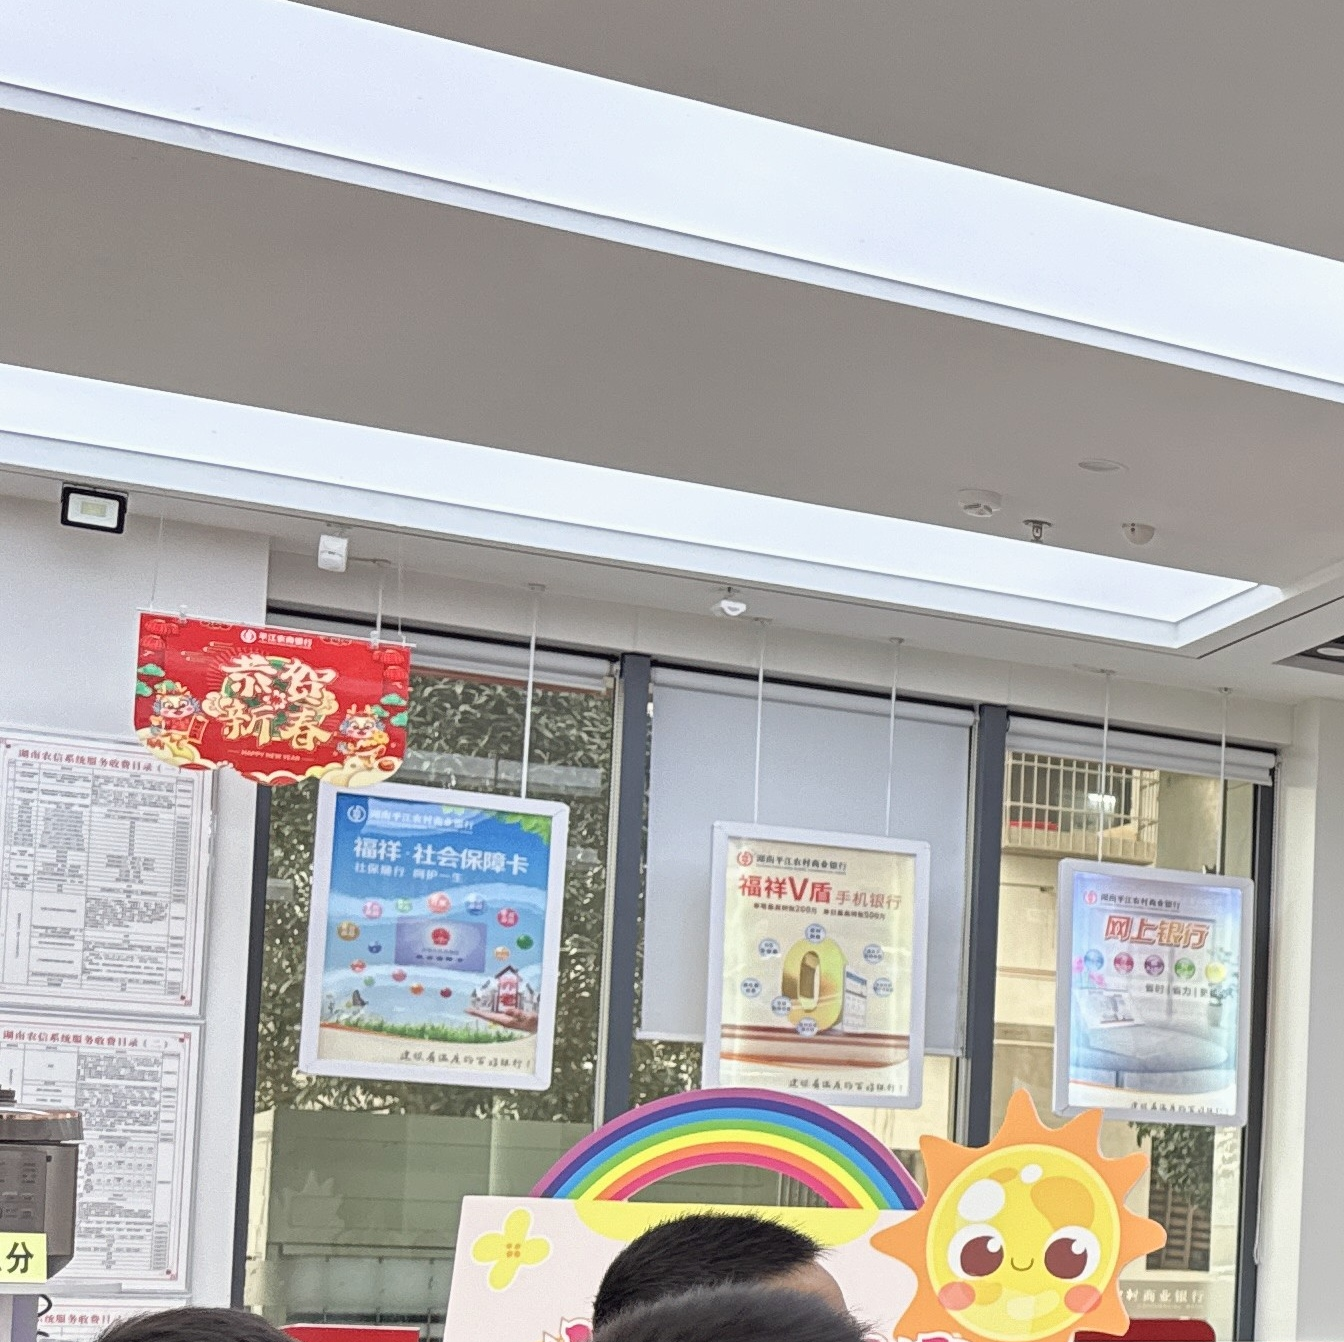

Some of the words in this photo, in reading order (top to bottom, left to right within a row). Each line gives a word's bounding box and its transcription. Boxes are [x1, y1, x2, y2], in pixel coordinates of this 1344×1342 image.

[220, 653, 338, 706] 恭贺
[219, 700, 334, 751] 新春
[738, 874, 833, 904] 福祥V盾
[836, 890, 903, 911] 手机银行
[1104, 914, 1212, 950] 网上银行
[0, 1240, 34, 1275] 分
